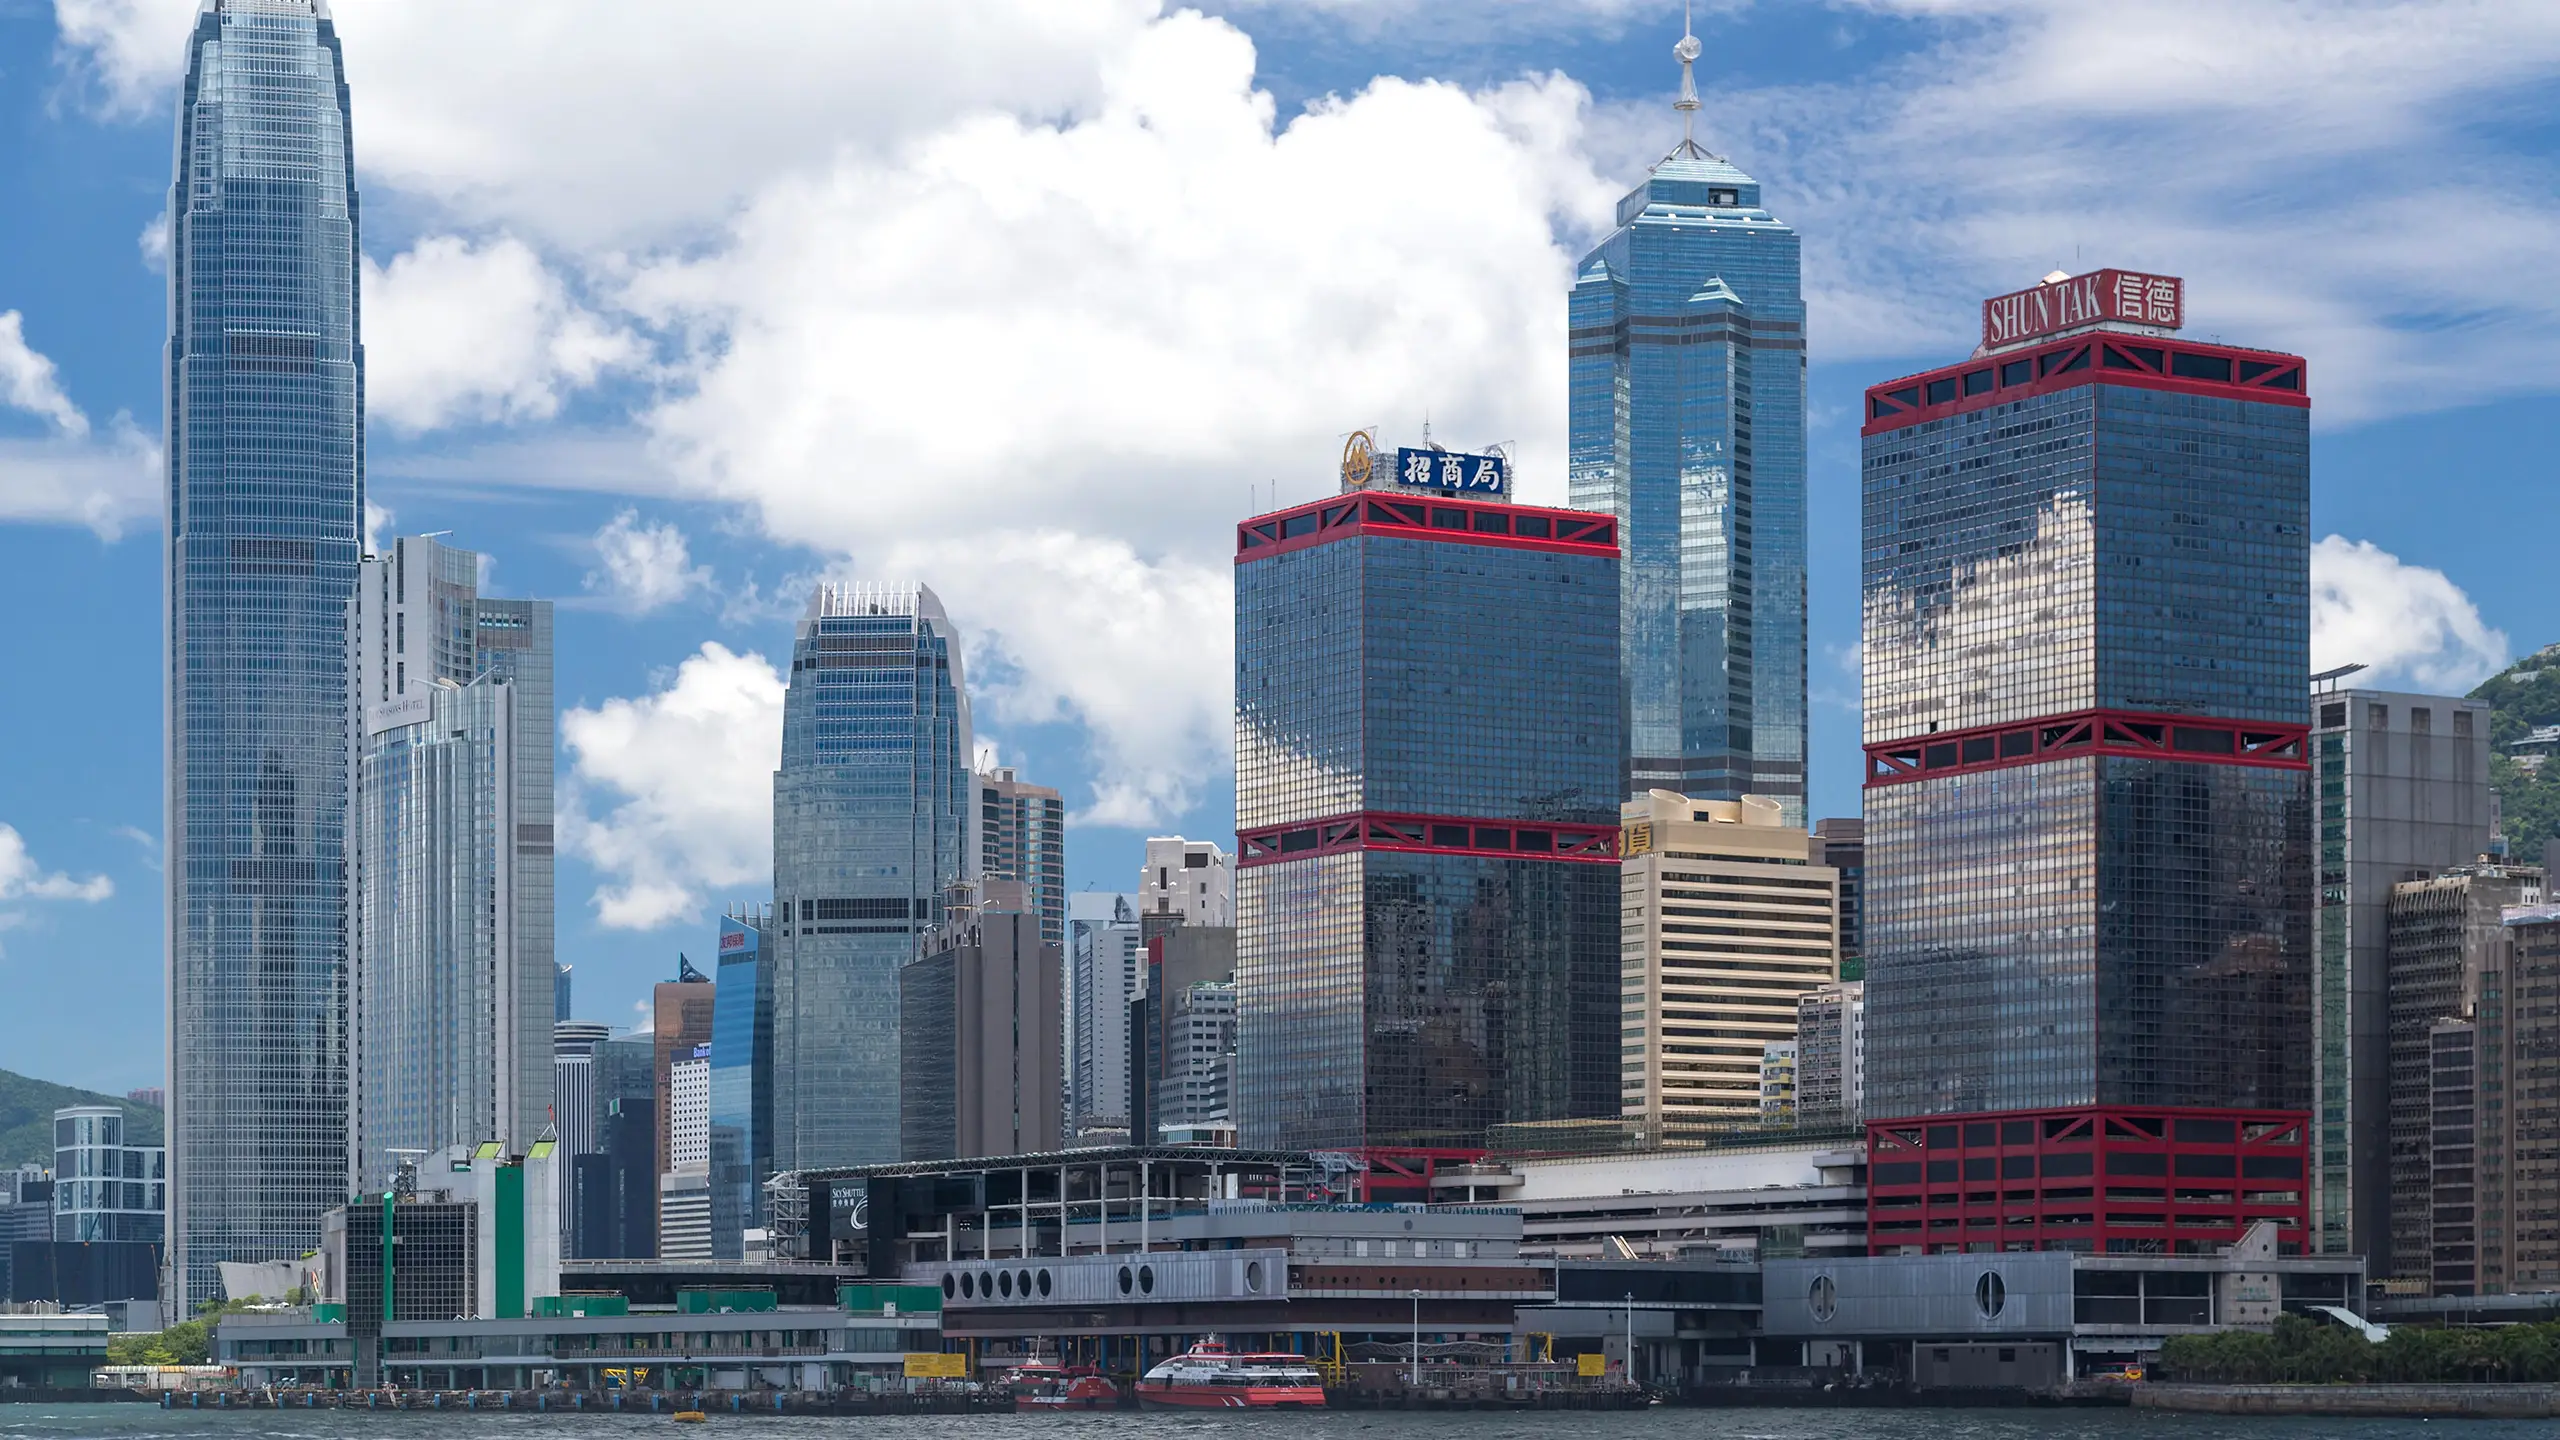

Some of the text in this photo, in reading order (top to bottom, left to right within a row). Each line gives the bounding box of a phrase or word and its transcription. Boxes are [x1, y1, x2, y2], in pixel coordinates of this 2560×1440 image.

[1990, 274, 2102, 342] SHUN TAK
[2112, 273, 2176, 323] 信德
[1404, 451, 1500, 491] 招商局
